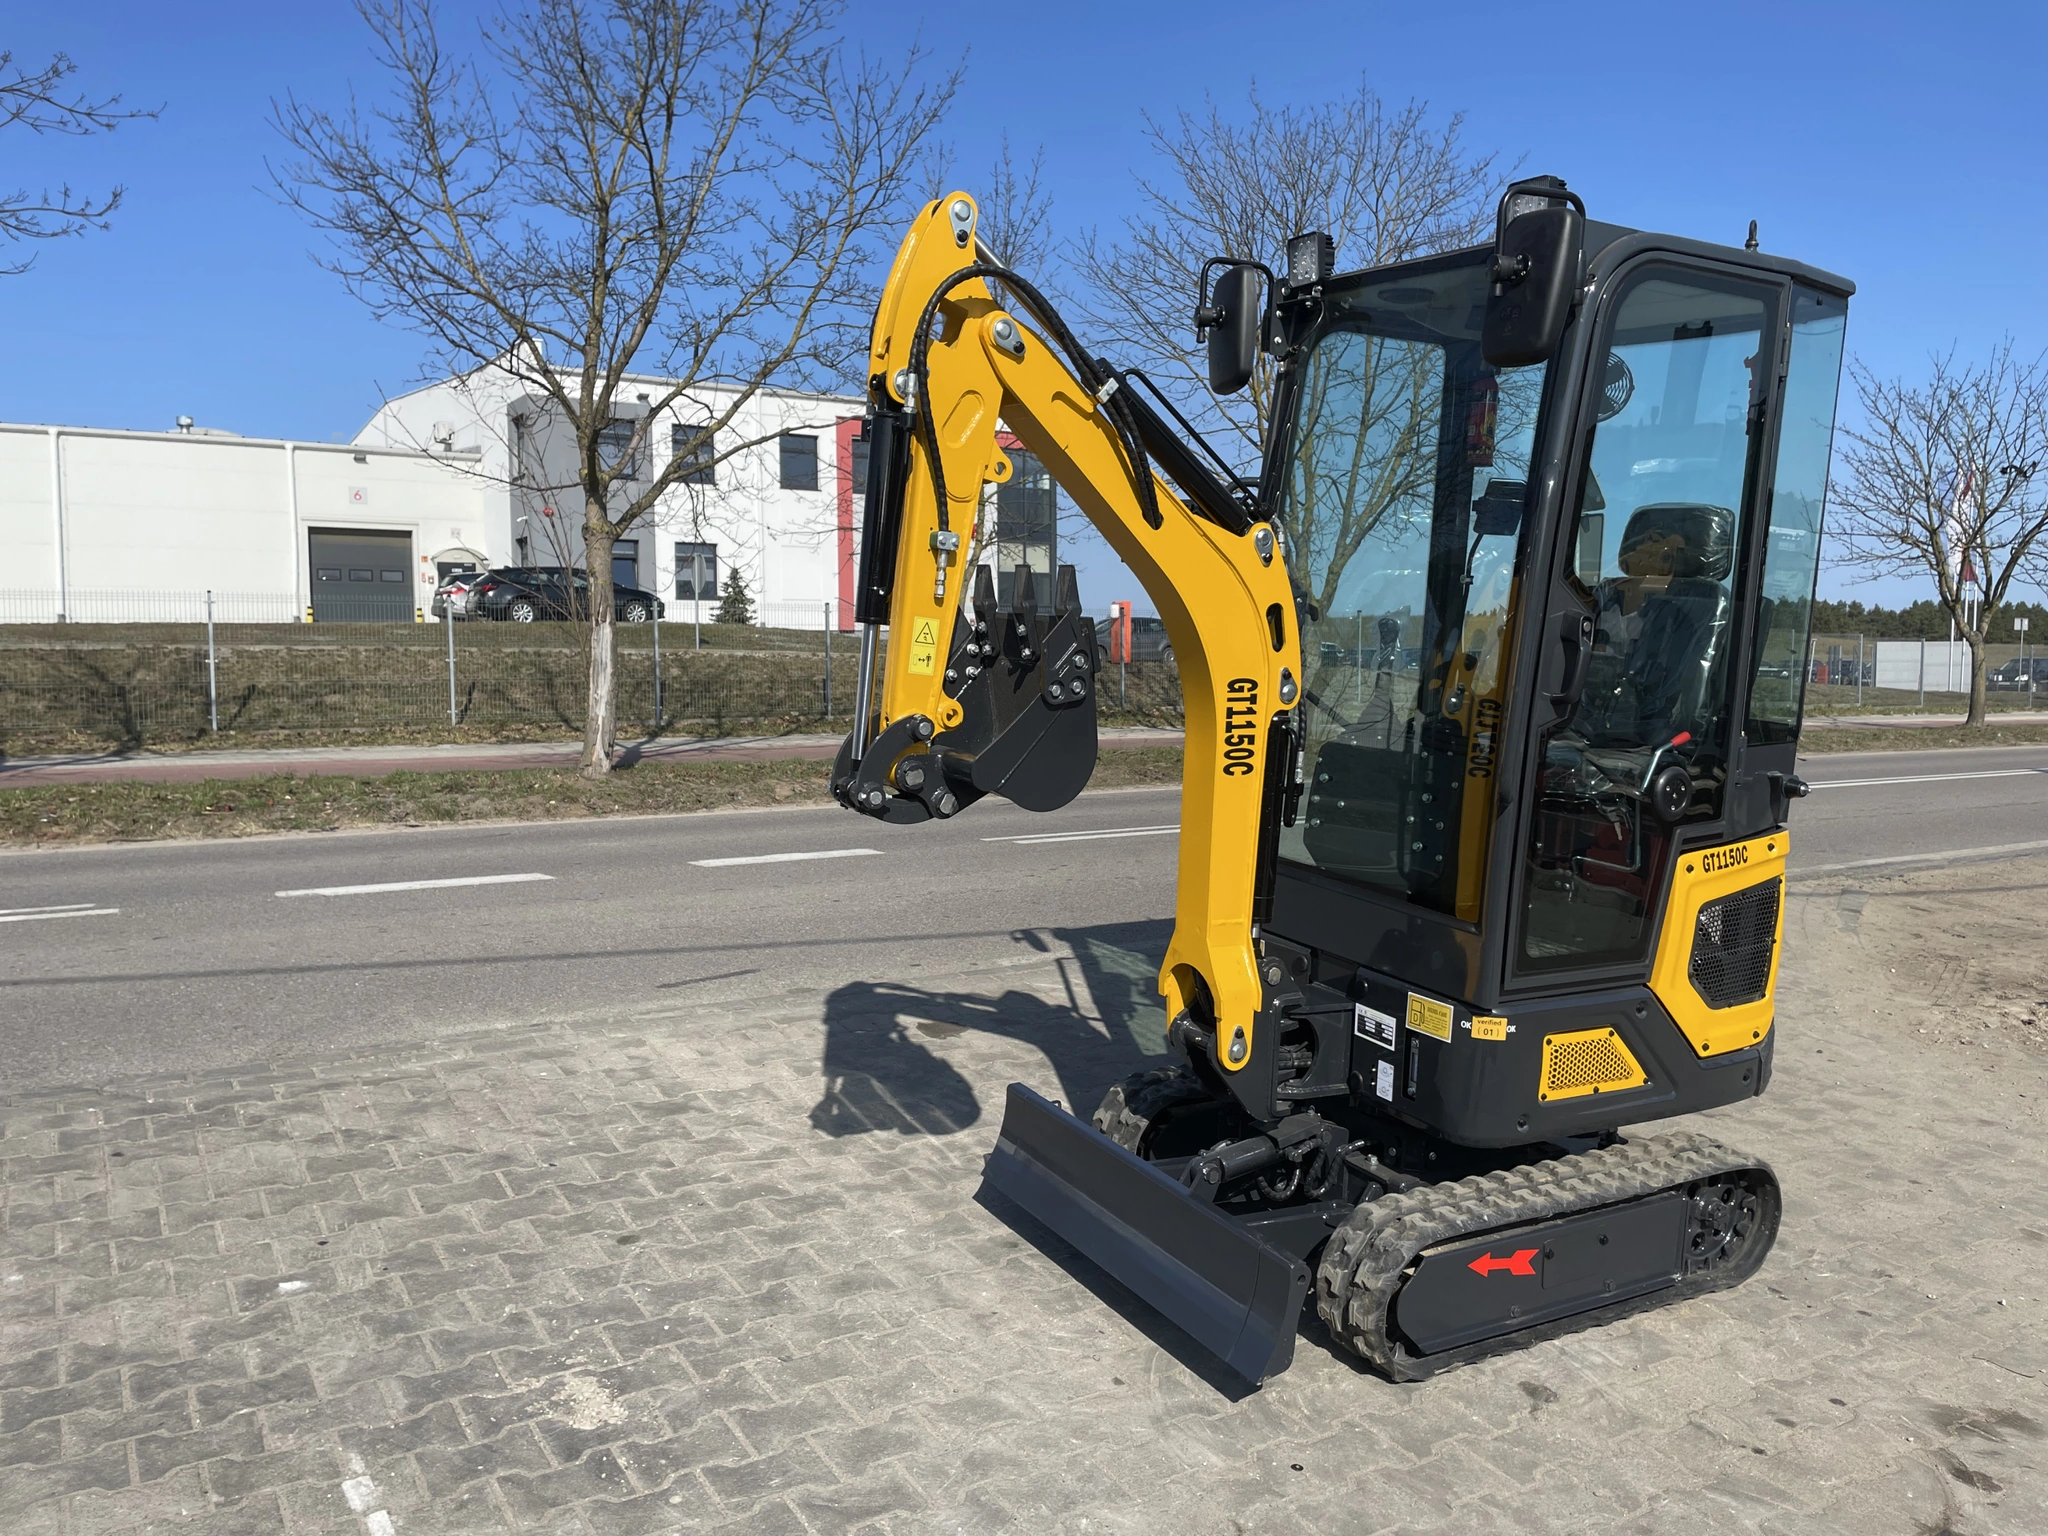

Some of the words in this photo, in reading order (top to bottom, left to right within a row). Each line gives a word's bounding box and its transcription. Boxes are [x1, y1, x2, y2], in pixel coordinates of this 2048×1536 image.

[354, 489, 362, 501] 6
[1223, 678, 1258, 776] GT1150C
[1702, 845, 1748, 873] GT1150C
[1413, 1013, 1418, 1022] D
[1460, 1020, 1472, 1029] OK
[1506, 1025, 1517, 1033] OK
